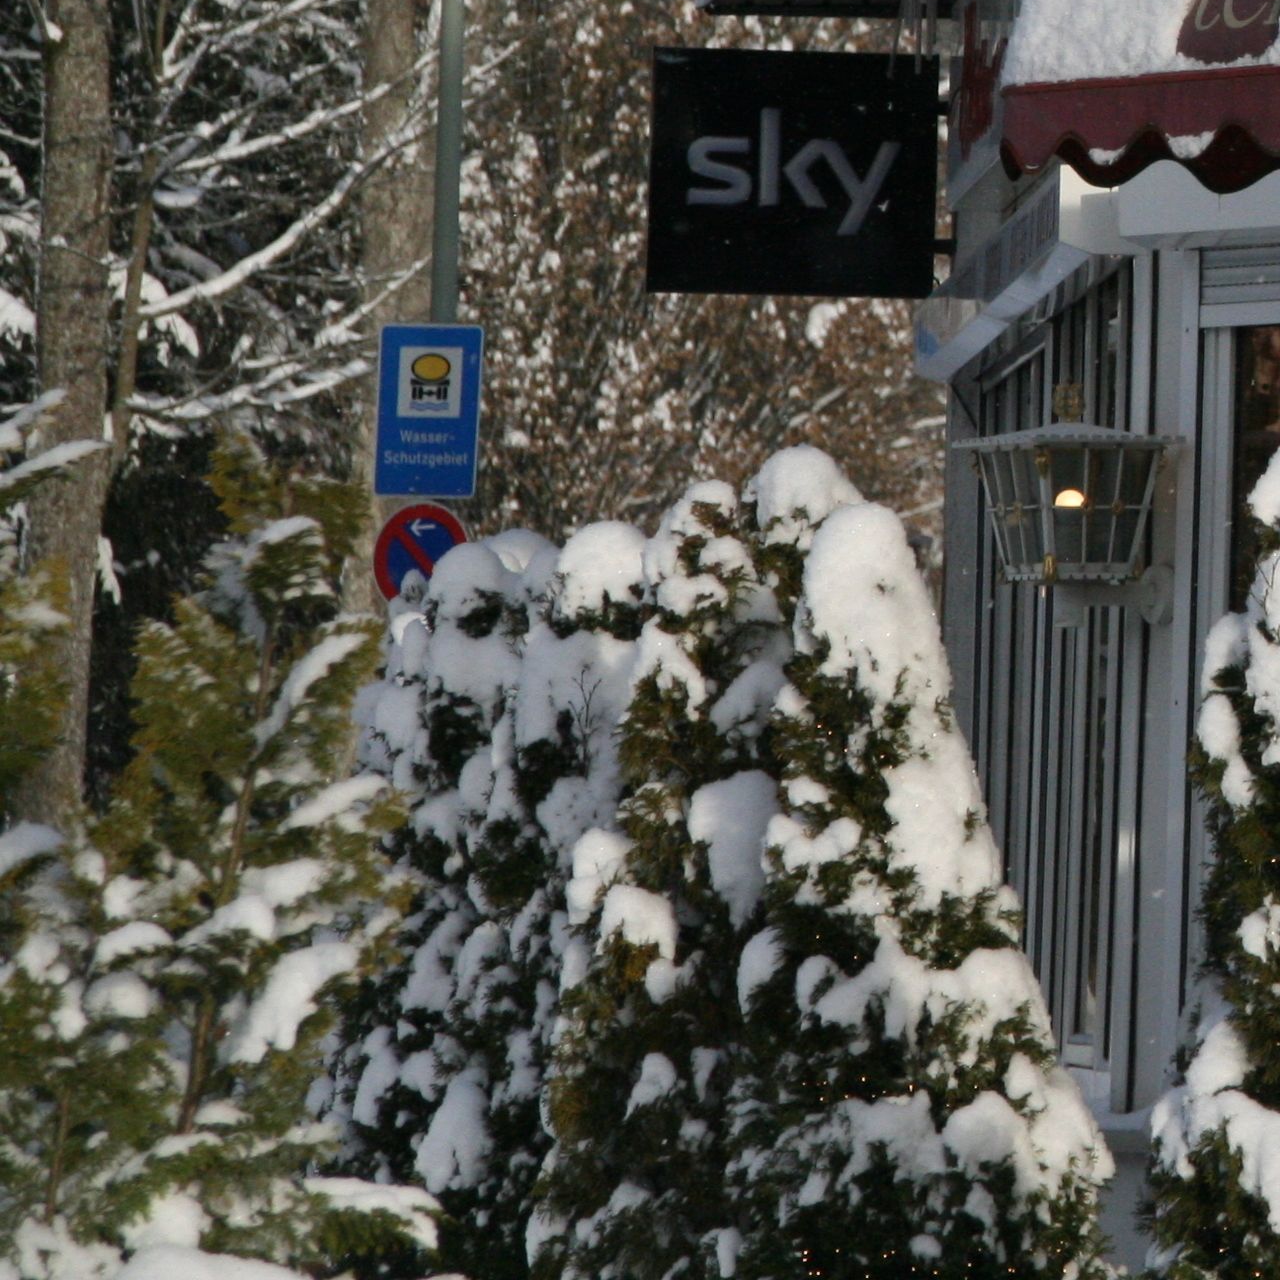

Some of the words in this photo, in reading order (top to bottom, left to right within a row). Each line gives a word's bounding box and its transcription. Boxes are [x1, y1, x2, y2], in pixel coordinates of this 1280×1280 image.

[687, 107, 900, 236] sky
[400, 429, 456, 444] Wasser-
[383, 450, 468, 469] Schutzgebiet
